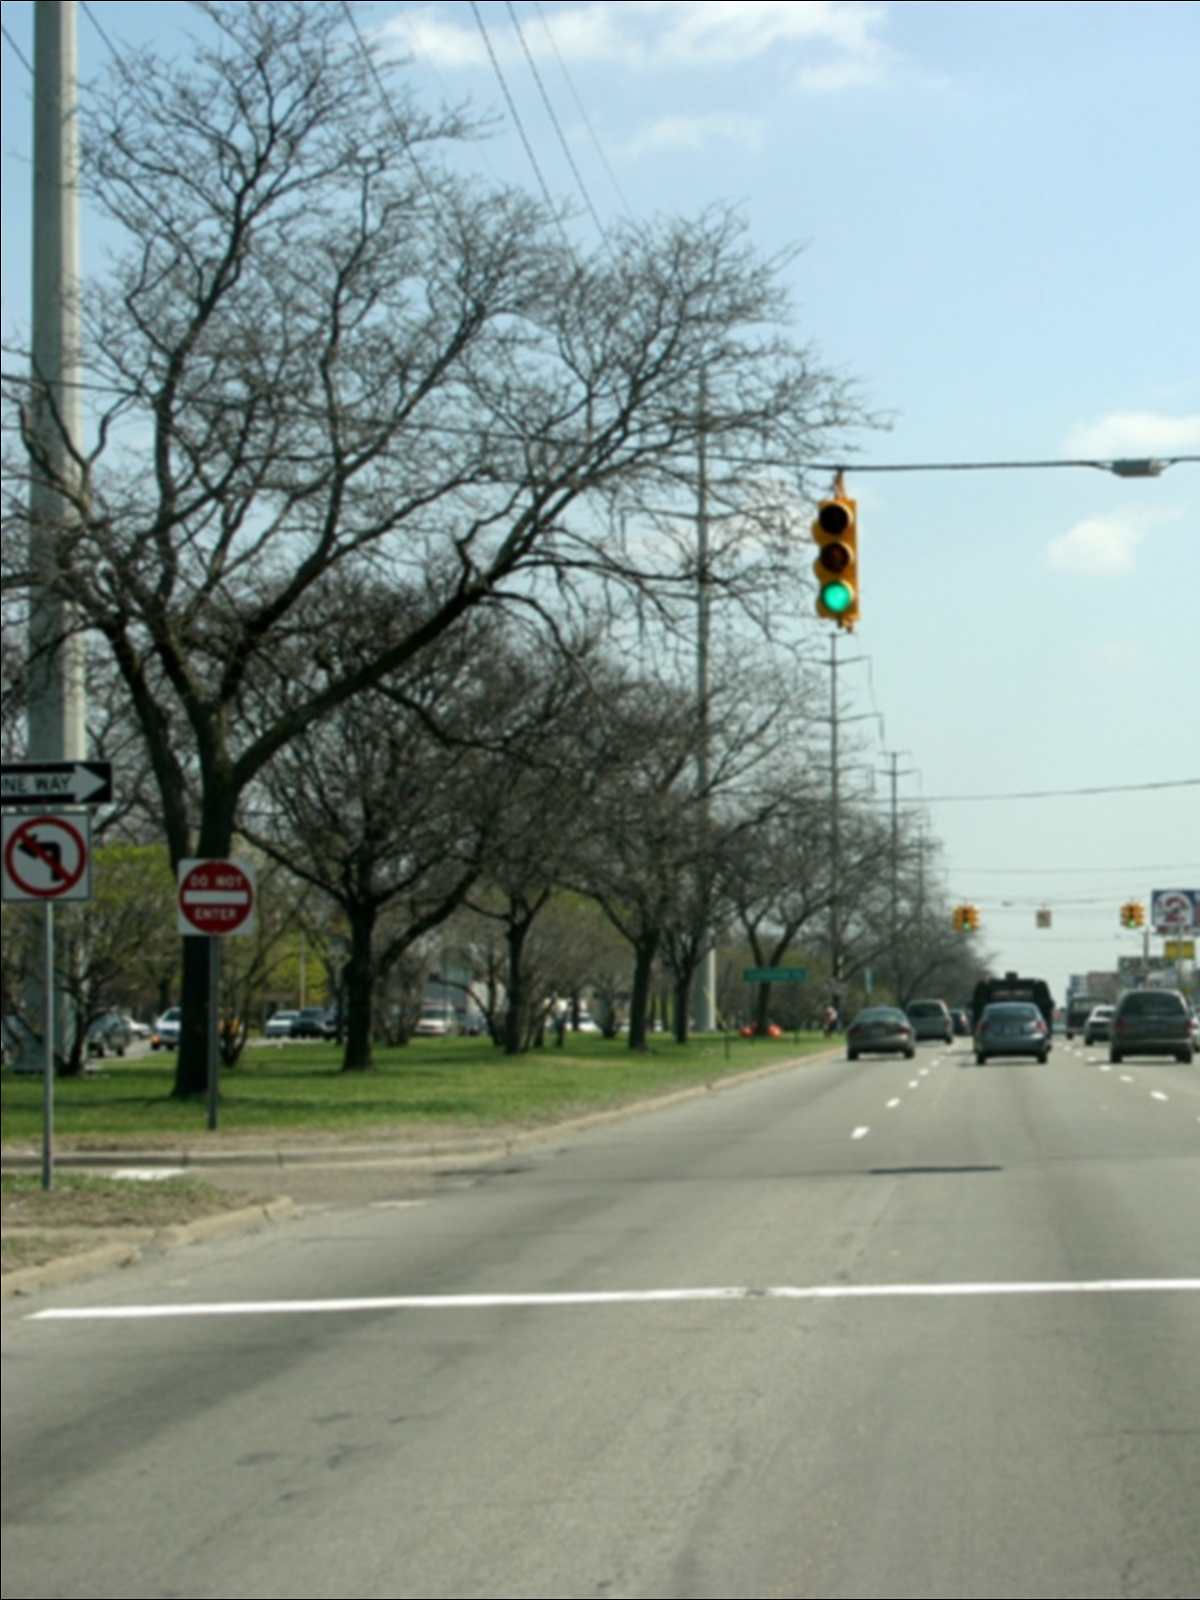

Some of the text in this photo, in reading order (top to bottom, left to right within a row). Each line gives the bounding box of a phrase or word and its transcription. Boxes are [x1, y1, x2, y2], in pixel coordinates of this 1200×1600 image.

[2, 775, 70, 793] NE WAY
[190, 874, 242, 888] DO NOT
[194, 907, 237, 920] ENTER
